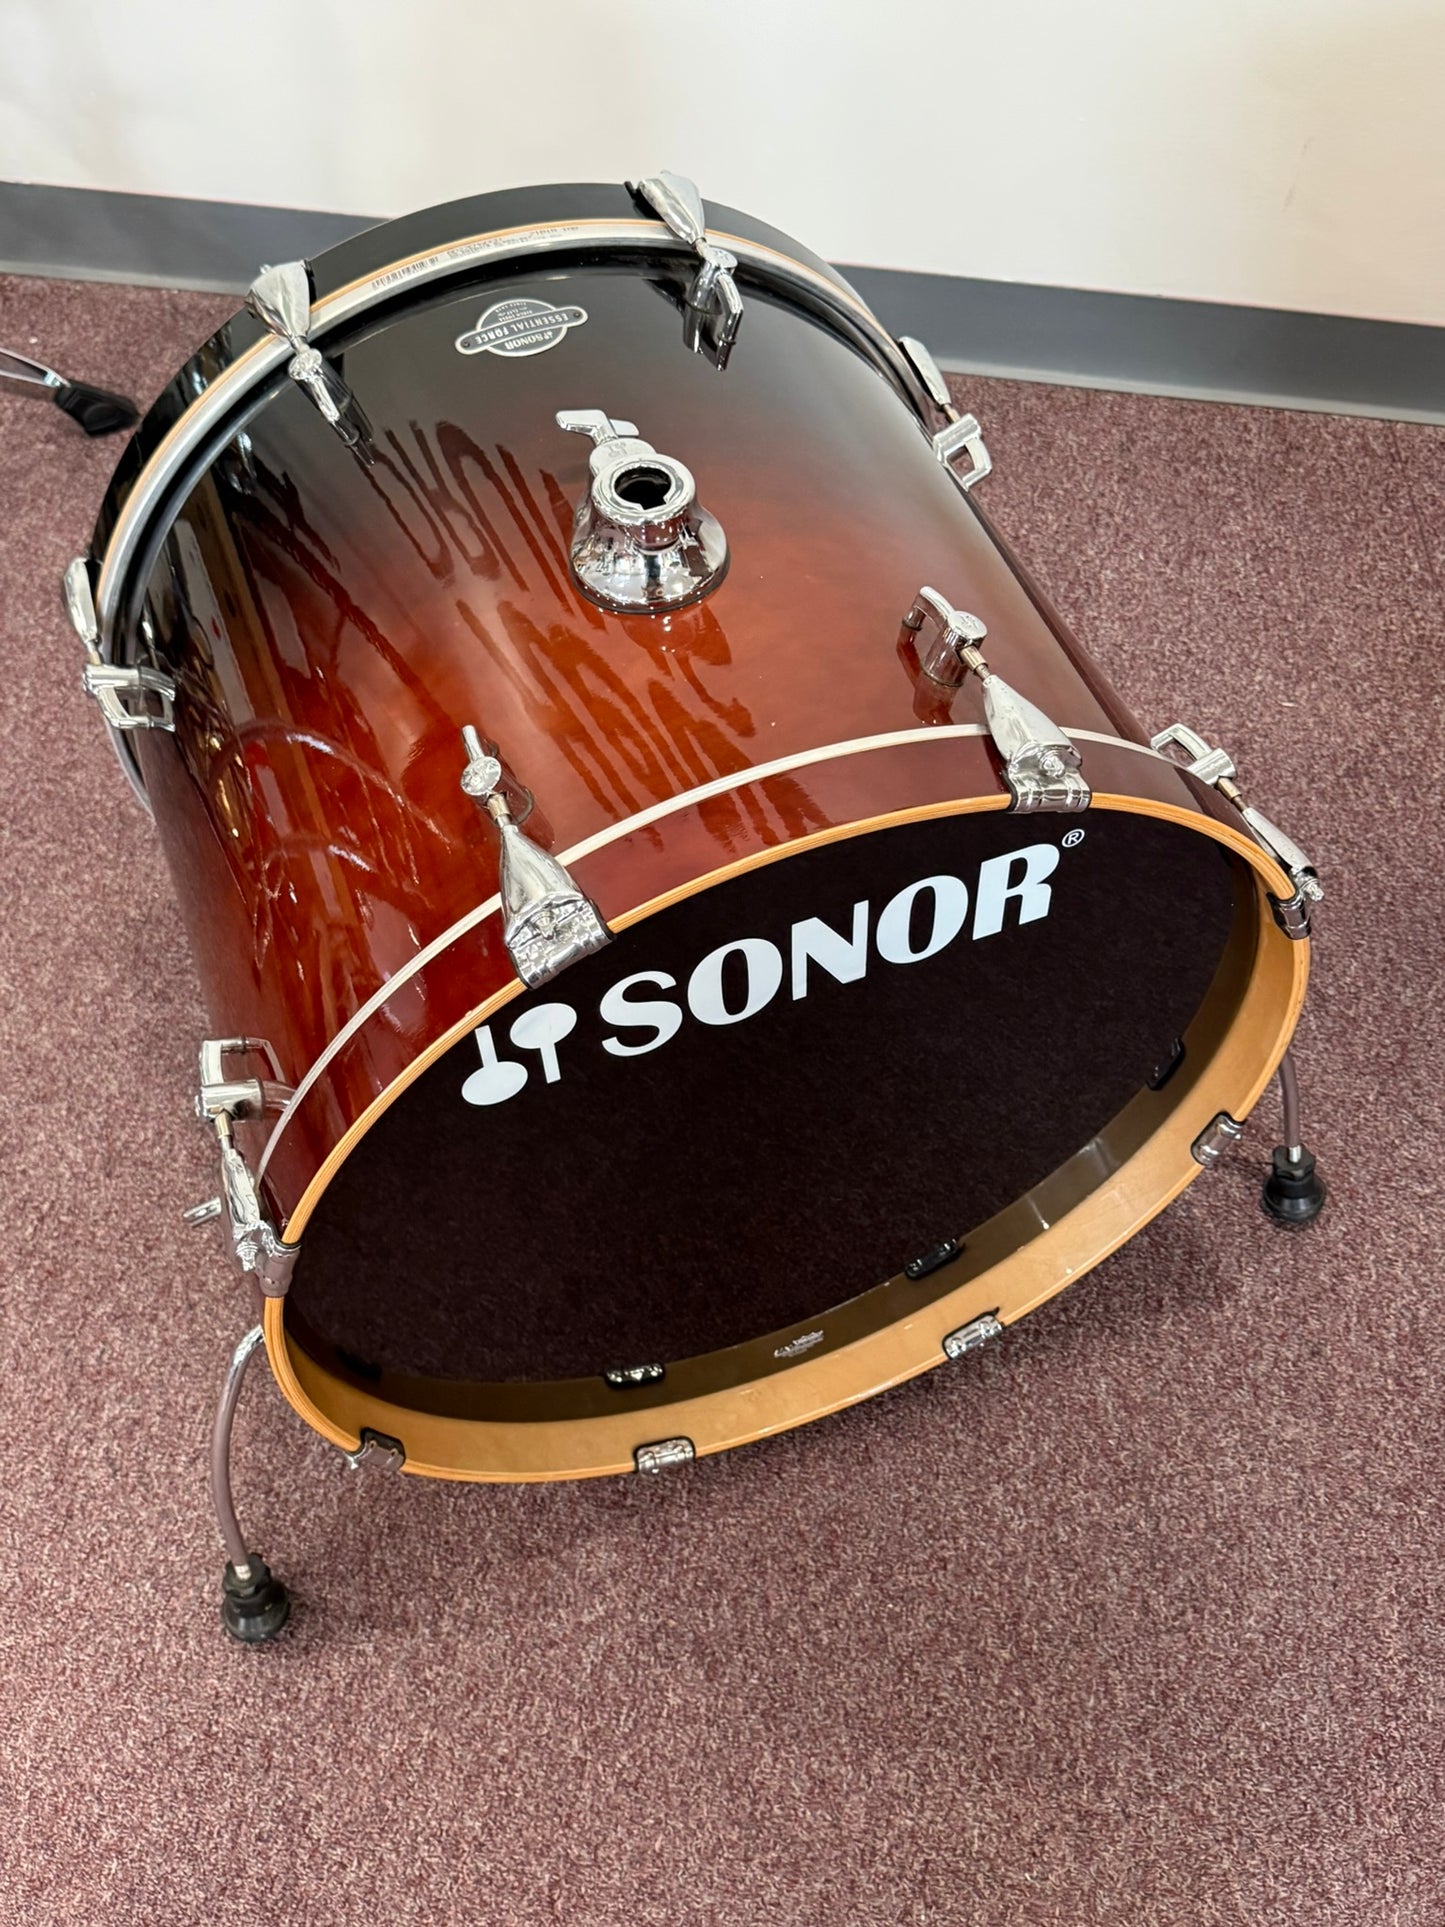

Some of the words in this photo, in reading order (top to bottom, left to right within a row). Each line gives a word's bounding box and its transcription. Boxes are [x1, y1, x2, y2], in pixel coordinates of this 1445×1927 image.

[510, 313, 569, 332] ESSENTIAL
[474, 326, 508, 345] FORCE
[504, 334, 543, 350] SONOR
